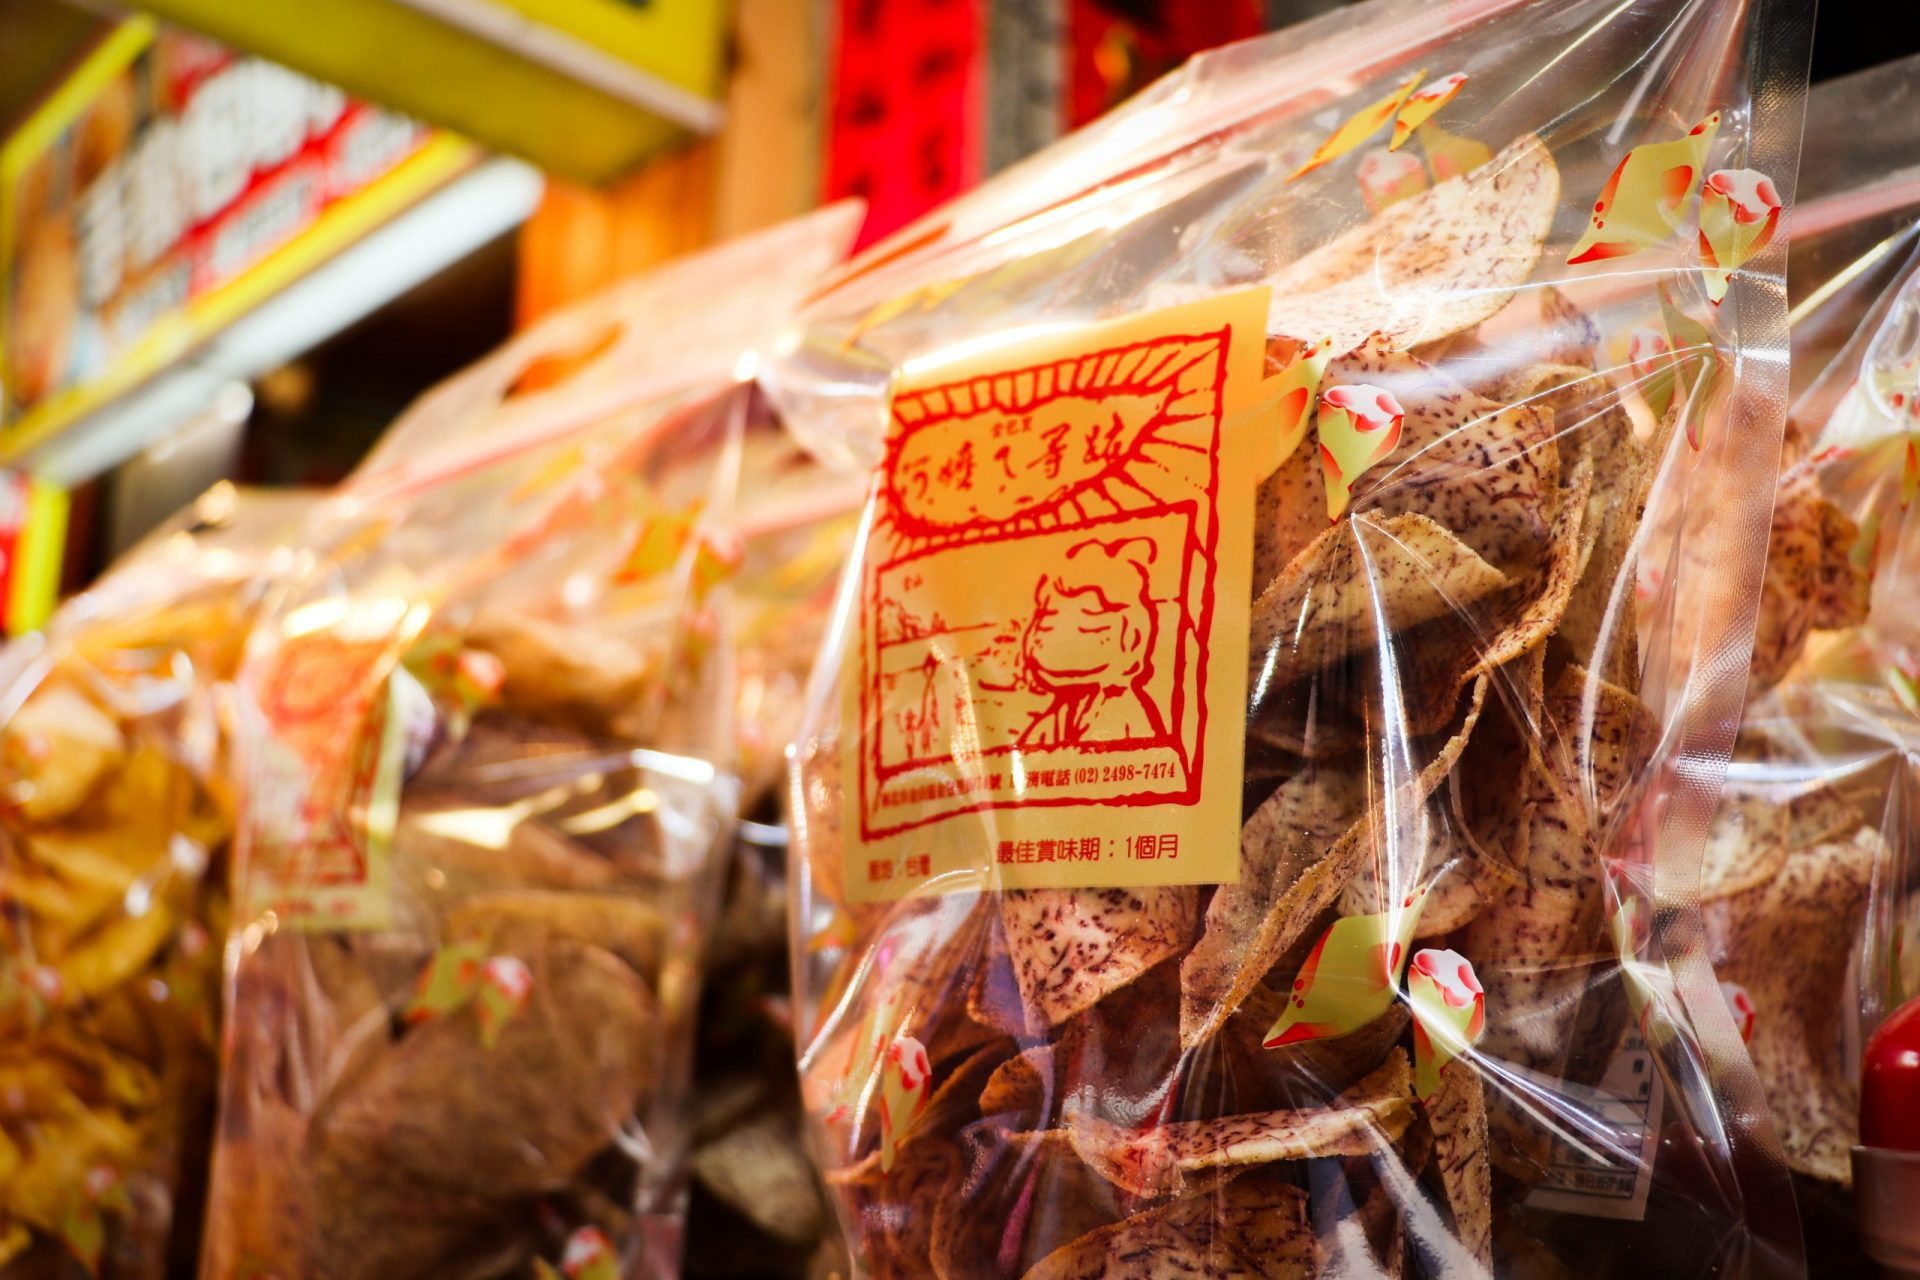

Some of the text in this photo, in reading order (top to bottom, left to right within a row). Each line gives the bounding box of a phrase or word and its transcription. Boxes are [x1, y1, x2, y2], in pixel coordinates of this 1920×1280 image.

[1010, 762, 1176, 789] 務電話 (02) 2498-7474
[997, 834, 1178, 864] 最佳賞味期：1個月
